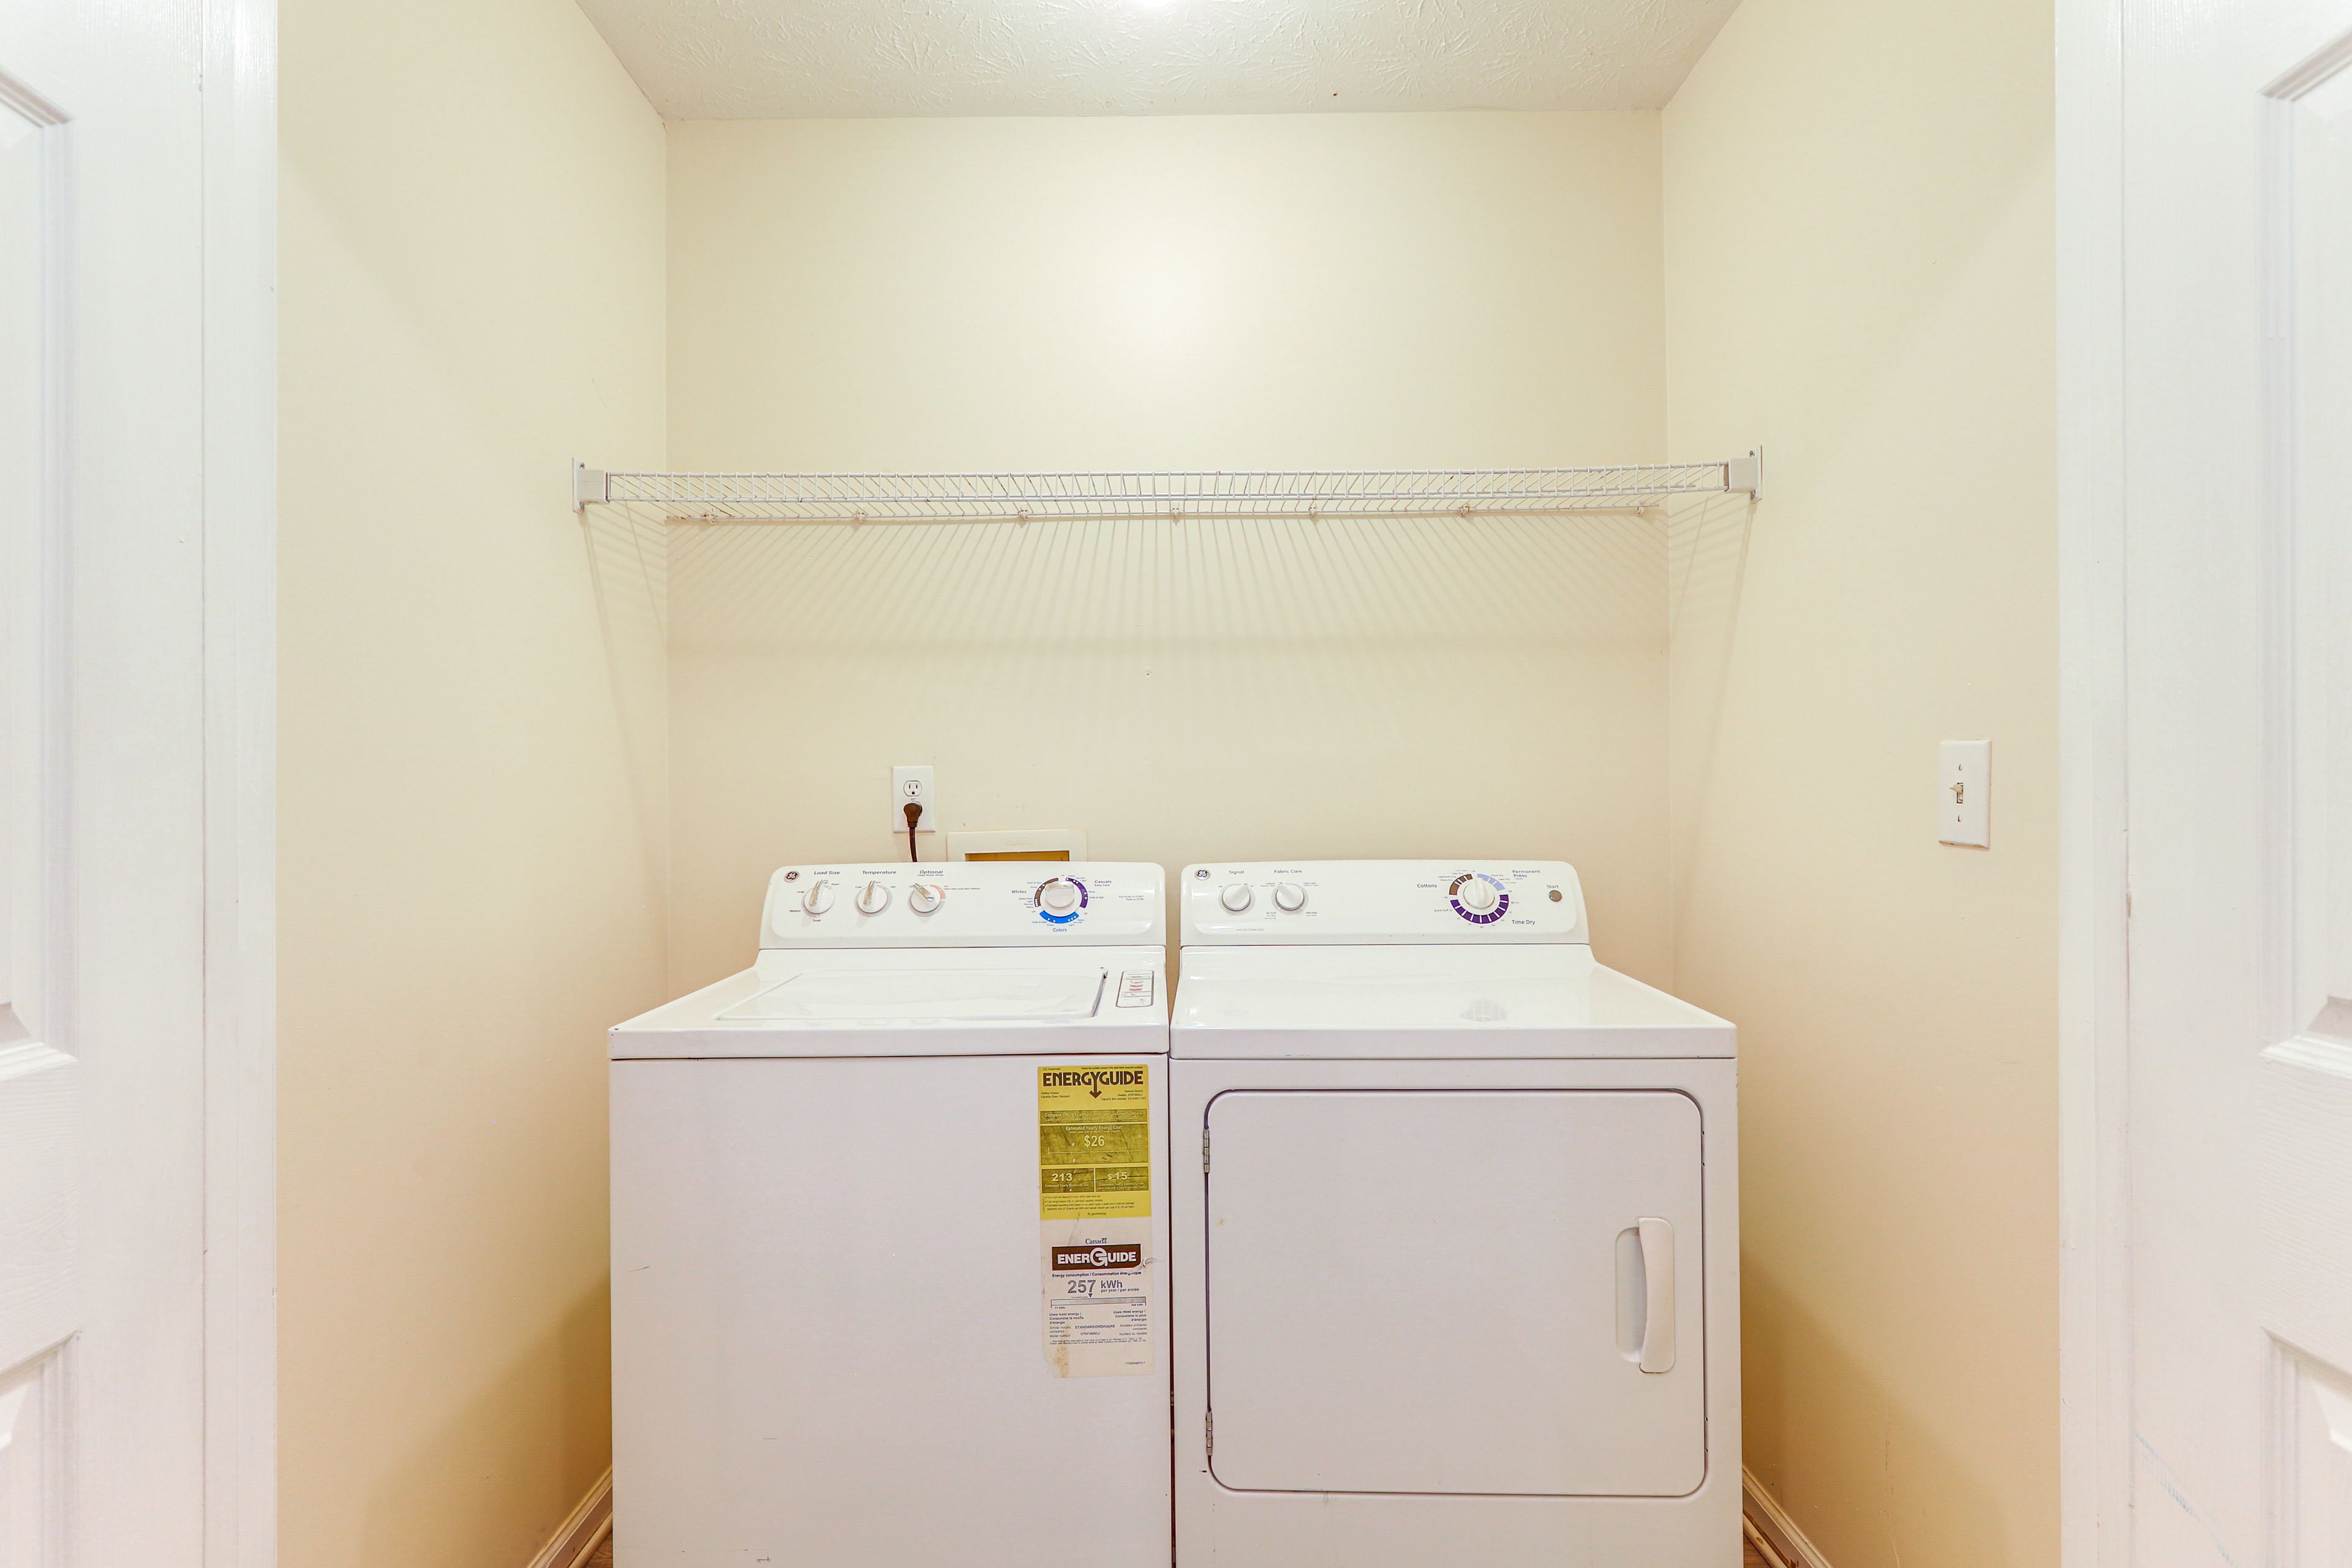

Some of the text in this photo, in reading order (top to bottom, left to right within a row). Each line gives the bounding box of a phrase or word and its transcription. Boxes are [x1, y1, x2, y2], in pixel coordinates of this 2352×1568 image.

[1043, 1071, 1144, 1087] ENERGYGUIDE
[1084, 1134, 1105, 1148] $26
[1052, 1173, 1072, 1182] 213
[1057, 1247, 1137, 1267] ENERGUIDE
[1068, 1280, 1123, 1294] 257 kWh
